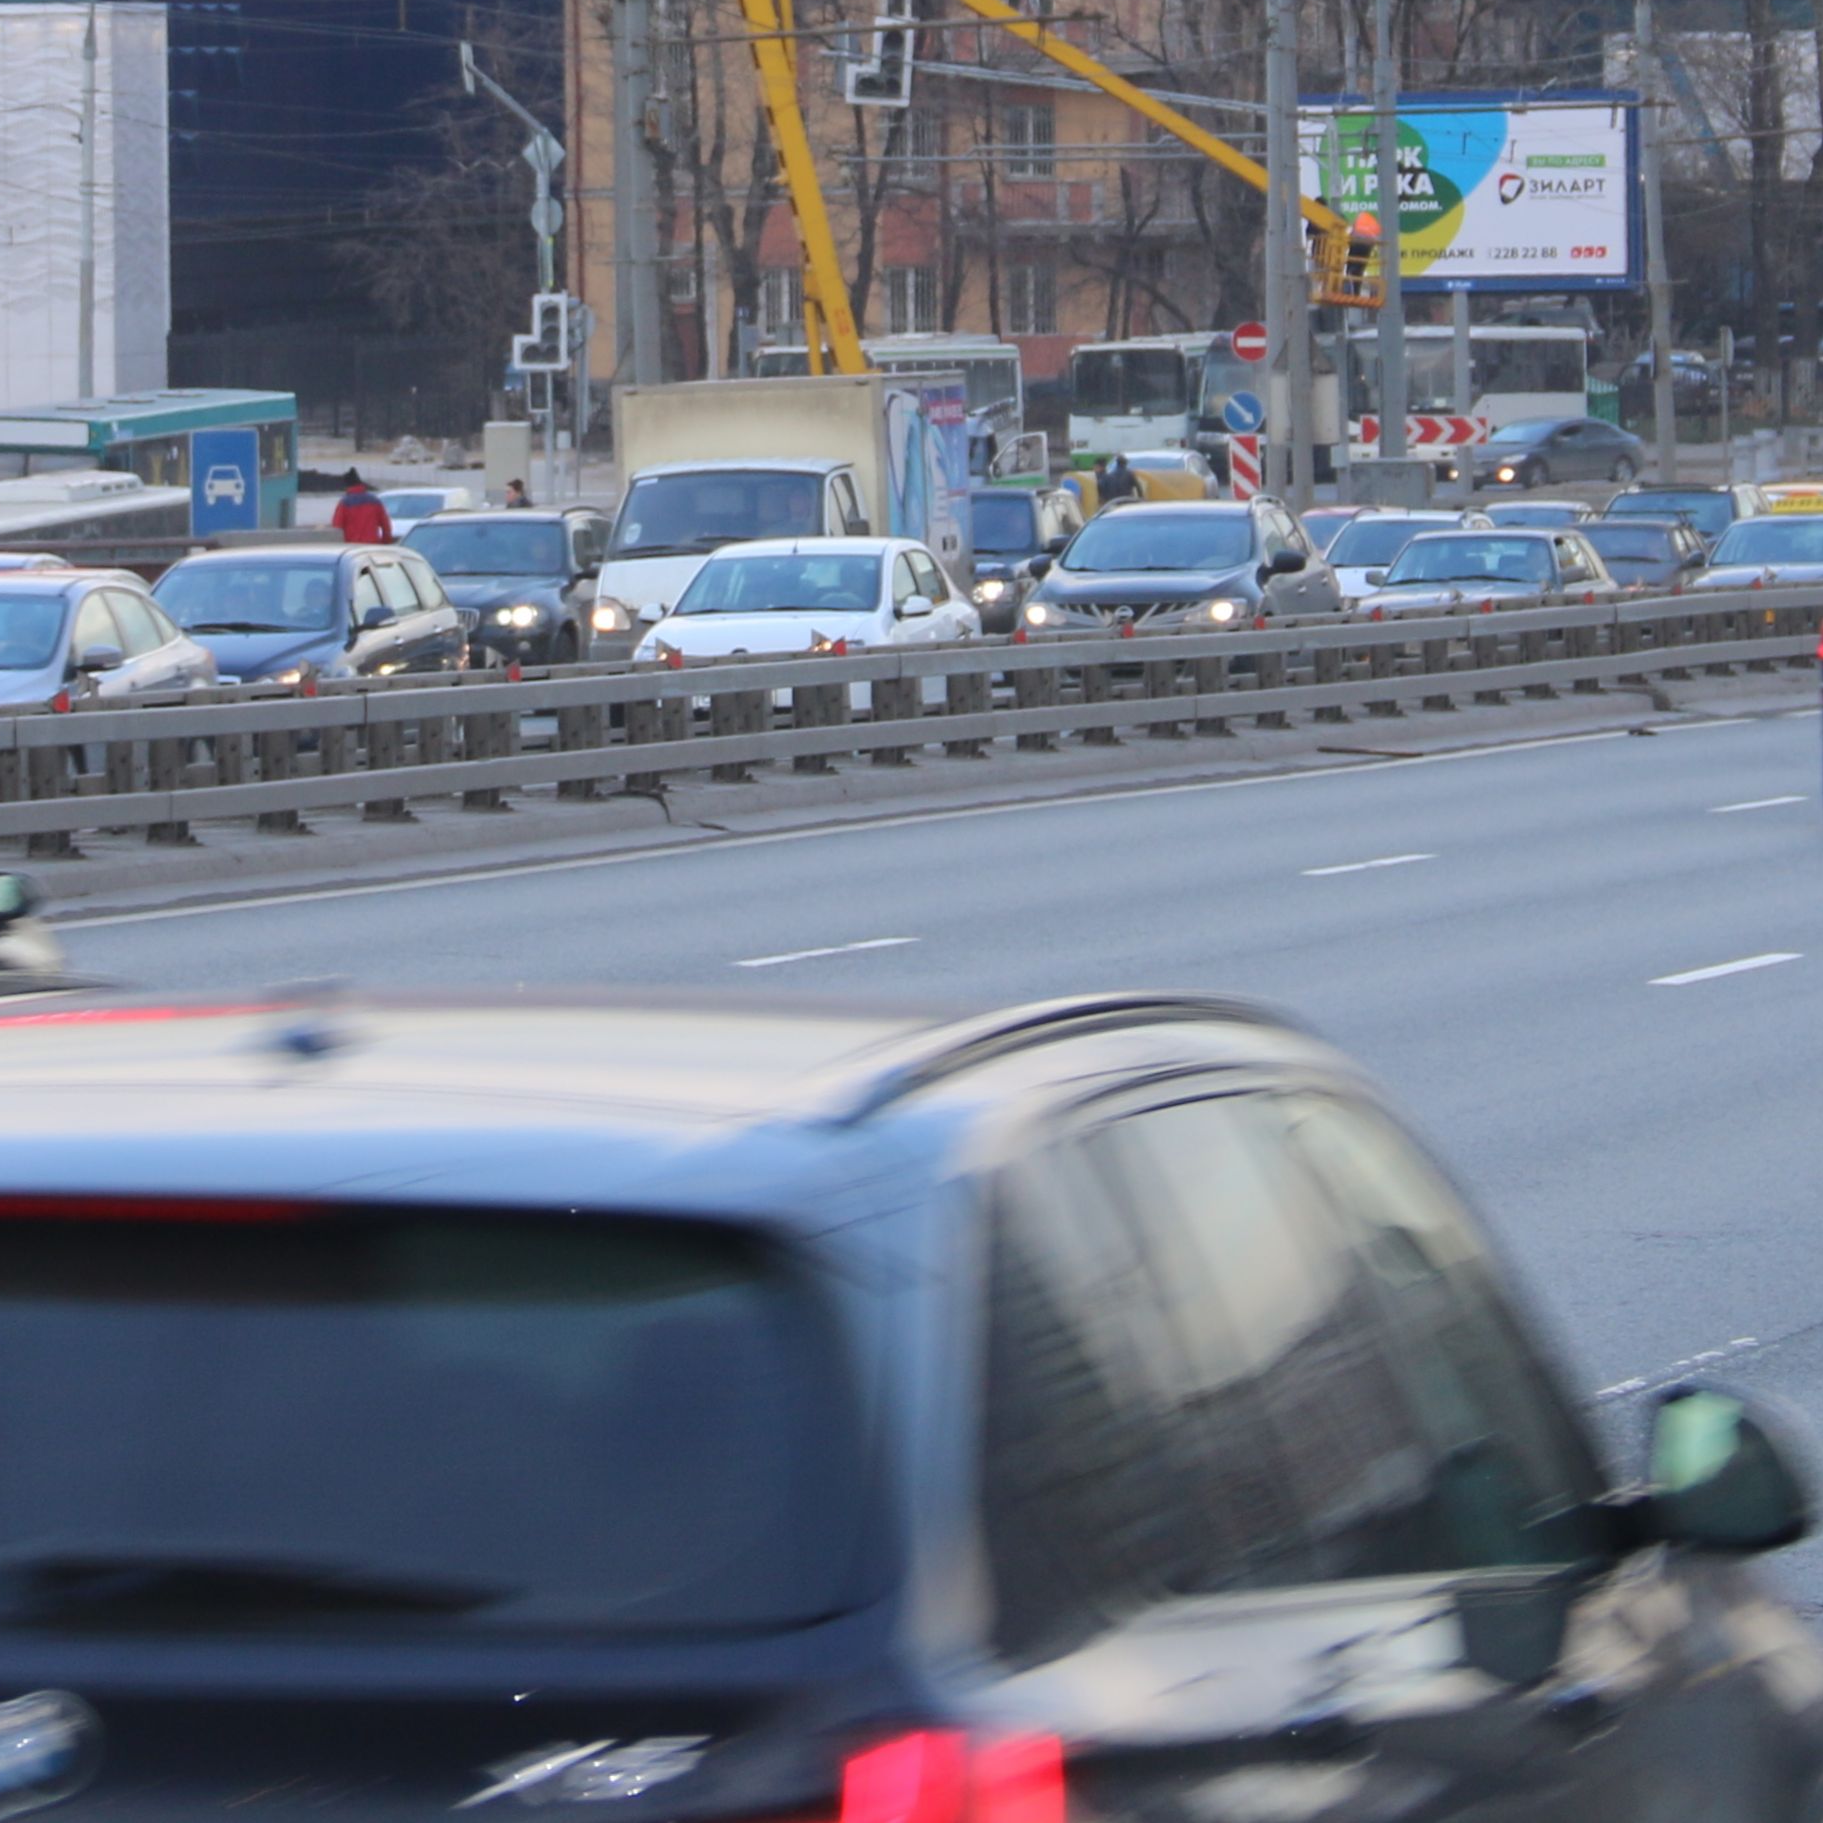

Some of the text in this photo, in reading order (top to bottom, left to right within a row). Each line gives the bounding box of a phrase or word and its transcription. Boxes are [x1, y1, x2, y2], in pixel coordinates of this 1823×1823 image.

[1364, 173, 1435, 195] РКА
[1528, 178, 1606, 194] ЗИЛАРТ
[1412, 246, 1475, 260] ПРОДАЖЕ
